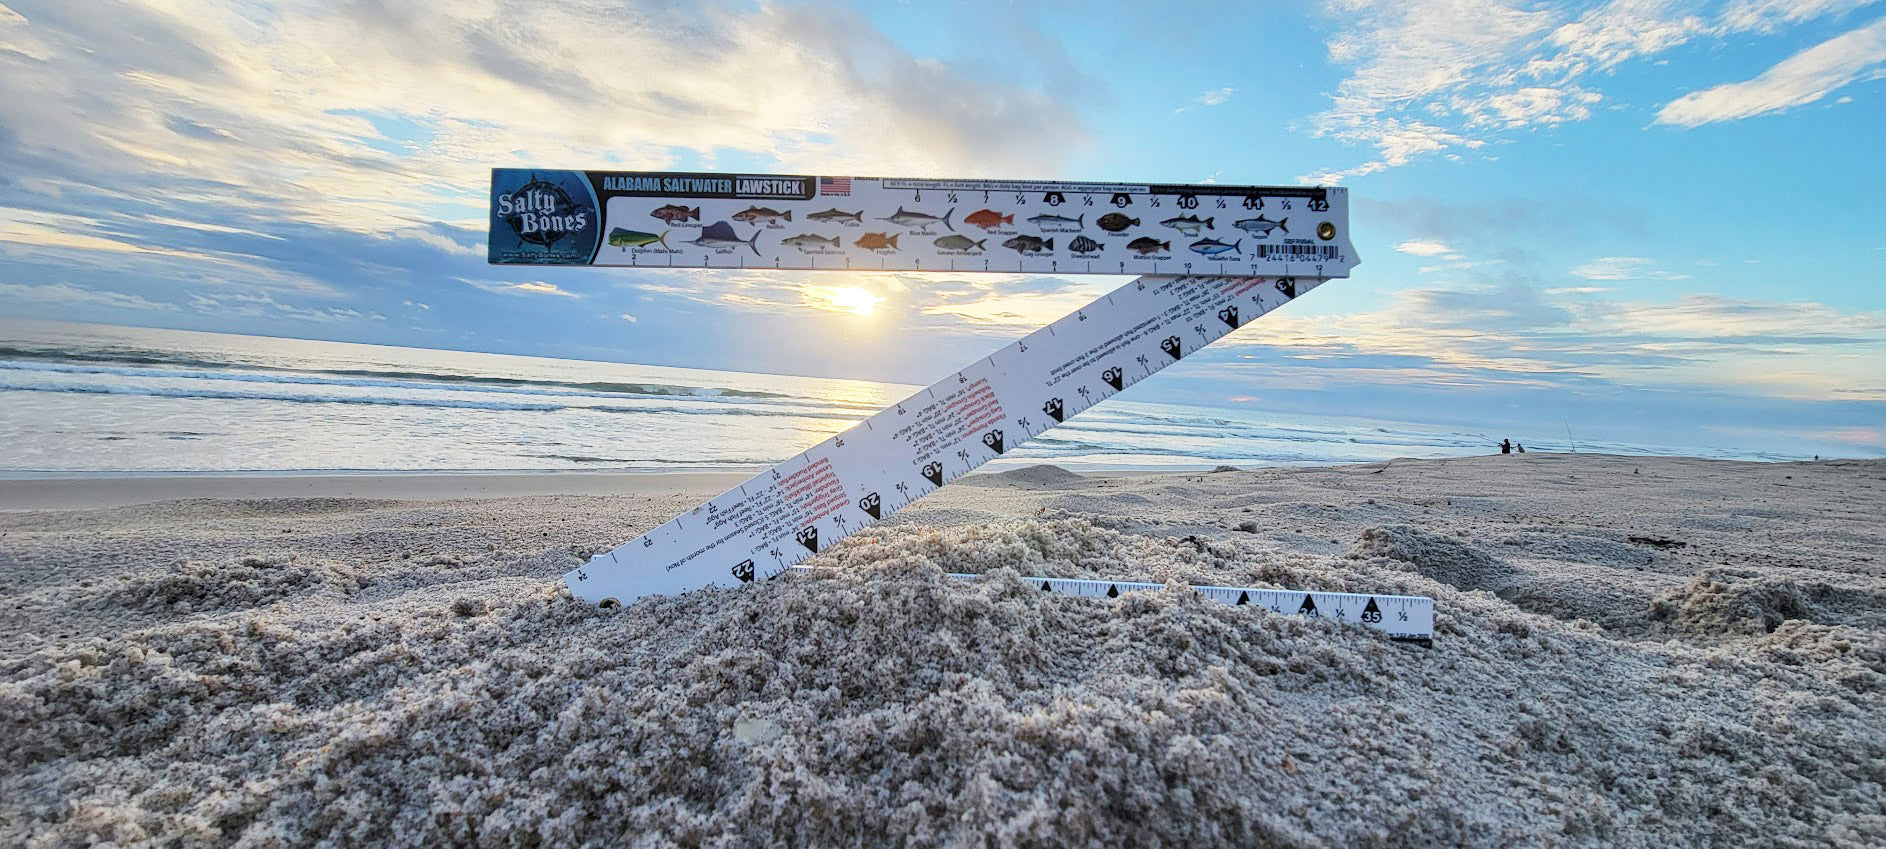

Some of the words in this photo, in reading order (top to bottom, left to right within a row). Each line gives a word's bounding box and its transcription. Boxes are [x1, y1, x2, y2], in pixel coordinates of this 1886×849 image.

[603, 176, 660, 191] ALABAMA
[663, 177, 732, 193] SALTWATER
[736, 179, 800, 195] LAWSTICK
[914, 193, 920, 202] 6
[1048, 194, 1059, 205] 8
[1116, 195, 1126, 206] 9
[1179, 196, 1197, 208] 10
[497, 189, 555, 218] Salty
[1244, 198, 1261, 209] 11
[1310, 200, 1327, 210] 12
[519, 211, 585, 235] Bones
[1340, 255, 1345, 263] 2
[1136, 282, 1145, 291] 15
[1275, 275, 1294, 292] 13
[1078, 313, 1087, 322] 16
[1218, 305, 1237, 322] 14
[1018, 344, 1028, 353] 17
[1160, 335, 1180, 352] 15
[958, 374, 967, 384] 18
[1101, 366, 1121, 383] 16
[896, 406, 906, 416] 19
[1042, 398, 1061, 414] 17
[987, 412, 1006, 426] Florida
[982, 429, 1003, 446] 18
[834, 439, 845, 448] 20
[807, 456, 828, 471] Banded
[921, 460, 943, 478] 19
[813, 463, 832, 476] Lesser
[770, 471, 781, 481] 21
[784, 471, 815, 492] Amberjack:
[811, 469, 835, 486] Tripletail
[766, 483, 776, 492] 14"
[774, 488, 784, 497] 14"
[827, 483, 843, 495] Gray
[753, 490, 764, 499] 22"
[761, 495, 772, 504] 22"
[798, 490, 829, 510] Triggerfish:
[803, 491, 813, 500] 14"
[825, 490, 846, 505] Striped
[730, 501, 744, 511] Reef
[762, 503, 774, 512] min
[773, 498, 783, 506] 18"
[829, 498, 850, 512] Greater
[859, 493, 880, 511] 20
[707, 504, 718, 514] 22
[719, 507, 731, 517] Fish
[738, 505, 752, 516] Reef
[755, 508, 763, 516] TL
[768, 507, 783, 518] BAG:
[790, 507, 800, 515] 15"
[802, 508, 812, 517] 16"
[727, 512, 739, 522] Fish
[738, 514, 752, 525] BAG:
[799, 507, 830, 527] Amberjack:
[742, 515, 764, 531] (Closed
[754, 523, 769, 534] BAG:
[784, 519, 792, 527] TL
[789, 524, 800, 533] 34"
[723, 527, 744, 541] Season
[767, 525, 782, 536] BAG:
[777, 529, 790, 539] min
[796, 526, 817, 544] 21
[642, 538, 653, 548] 23
[705, 542, 715, 551] the
[715, 538, 724, 546] for
[753, 541, 768, 552] BAG:
[686, 547, 706, 561] month
[664, 560, 679, 572] Nov)
[678, 557, 687, 565] of
[731, 559, 754, 578] 22
[577, 572, 587, 582] 24
[1363, 611, 1381, 622] 35
